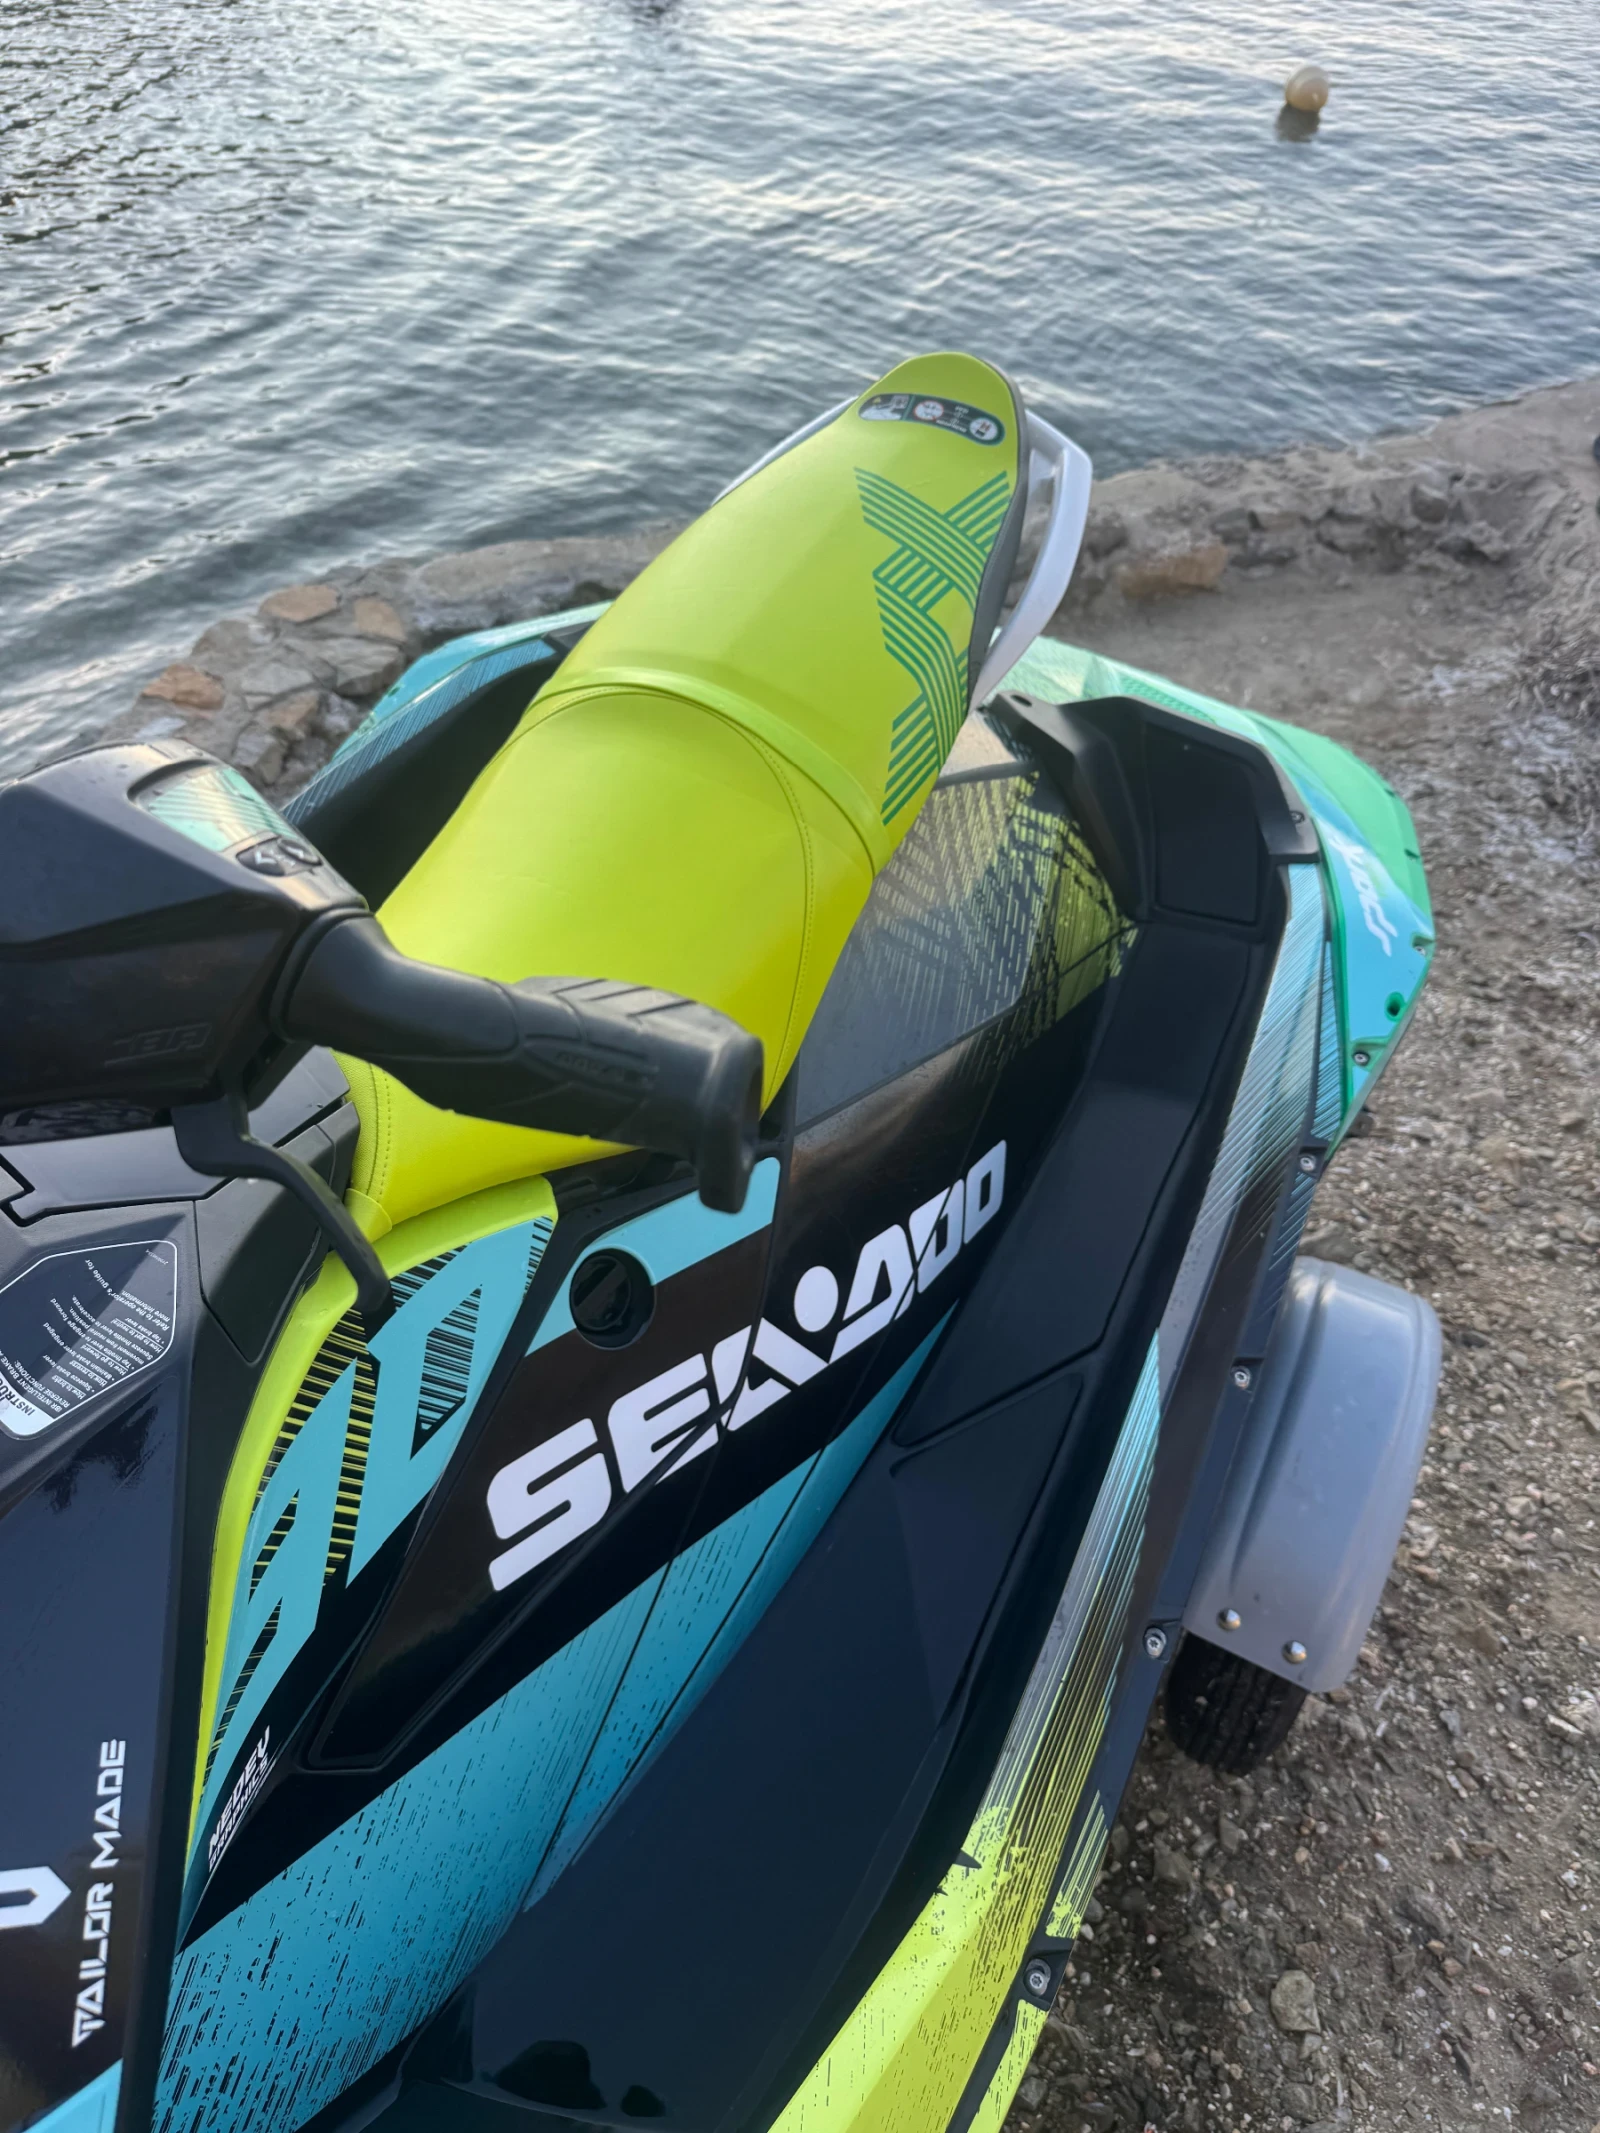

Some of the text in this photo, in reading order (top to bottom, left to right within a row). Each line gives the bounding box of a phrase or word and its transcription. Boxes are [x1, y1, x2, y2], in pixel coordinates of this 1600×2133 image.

[92, 1269, 109, 1289] guide
[106, 1287, 136, 1309] operator's
[120, 1289, 170, 1323] more information.
[50, 1297, 69, 1321] forward
[72, 1294, 96, 1323] accelerate.
[66, 1320, 86, 1338] engage
[99, 1324, 114, 1336] lever
[110, 1318, 130, 1332] neutral
[124, 1317, 139, 1327] lever
[137, 1324, 153, 1337] brake
[151, 1317, 170, 1331] Refer
[69, 1305, 145, 1365] movement from neutral position.
[90, 1339, 105, 1350] lever
[112, 1332, 133, 1347] throttle
[42, 1322, 113, 1380] Maintain brake lever engaged
[80, 1344, 102, 1360] forward
[103, 1347, 123, 1361] throttle
[130, 1343, 154, 1360] Squeeze
[0, 1356, 20, 1380] BRAKE
[42, 1354, 93, 1391] Squeeze brake lever
[68, 1359, 89, 1375] reverse
[13, 1359, 71, 1408] REVERSE FUNCTIONS:
[51, 1374, 67, 1388] brake
[16, 1377, 53, 1406] INTELLIGENT
[208, 1725, 270, 1860] NEDEV
[208, 1752, 268, 1873] GRAPHICS
[71, 1738, 126, 2048] TAILOR MADE
